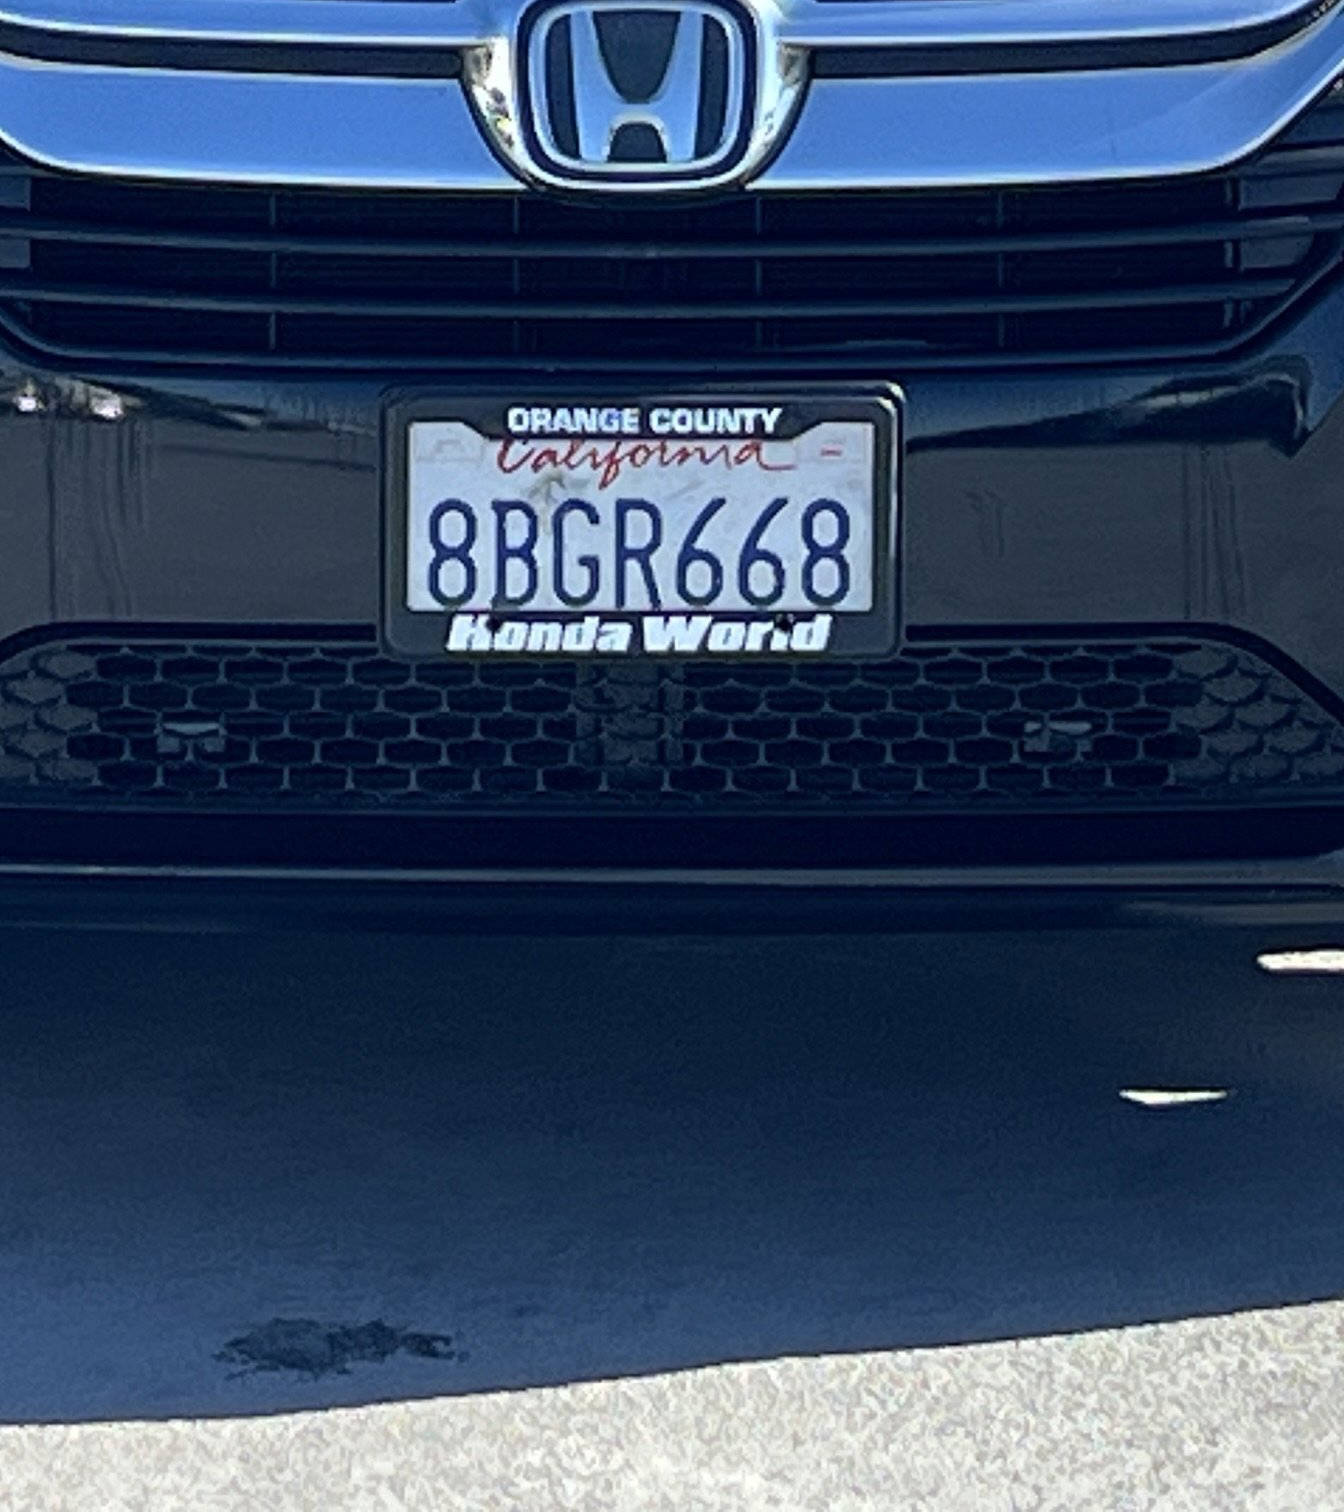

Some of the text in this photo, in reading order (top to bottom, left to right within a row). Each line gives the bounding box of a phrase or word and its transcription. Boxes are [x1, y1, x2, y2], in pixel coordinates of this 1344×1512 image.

[507, 406, 783, 434] ORANGE COUNTY
[496, 438, 798, 491] California
[428, 497, 851, 609] 8BGR668
